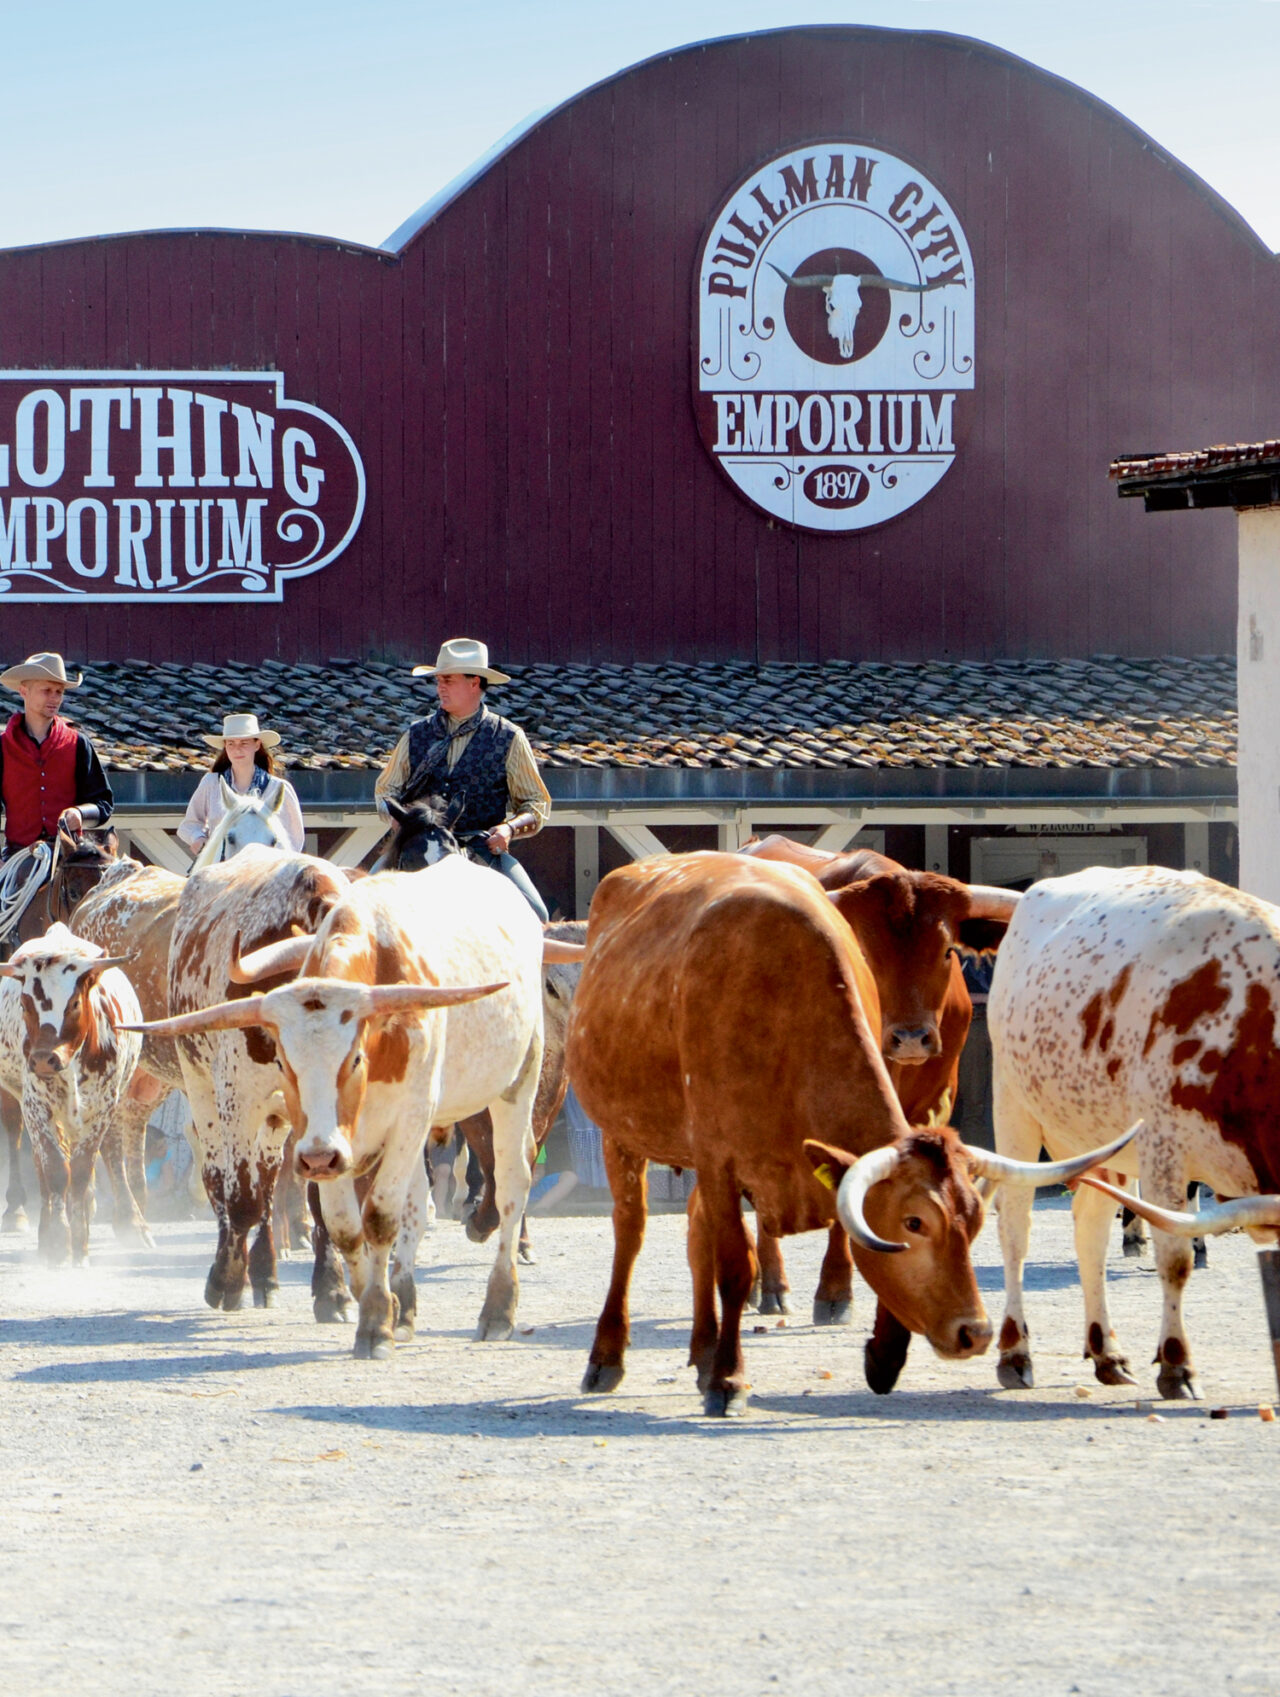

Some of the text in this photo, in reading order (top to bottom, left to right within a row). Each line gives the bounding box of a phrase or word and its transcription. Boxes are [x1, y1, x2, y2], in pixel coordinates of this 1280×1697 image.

[709, 154, 967, 299] PULLMAN CITY
[712, 394, 956, 453] EMPORIUM
[813, 472, 862, 500] 1897
